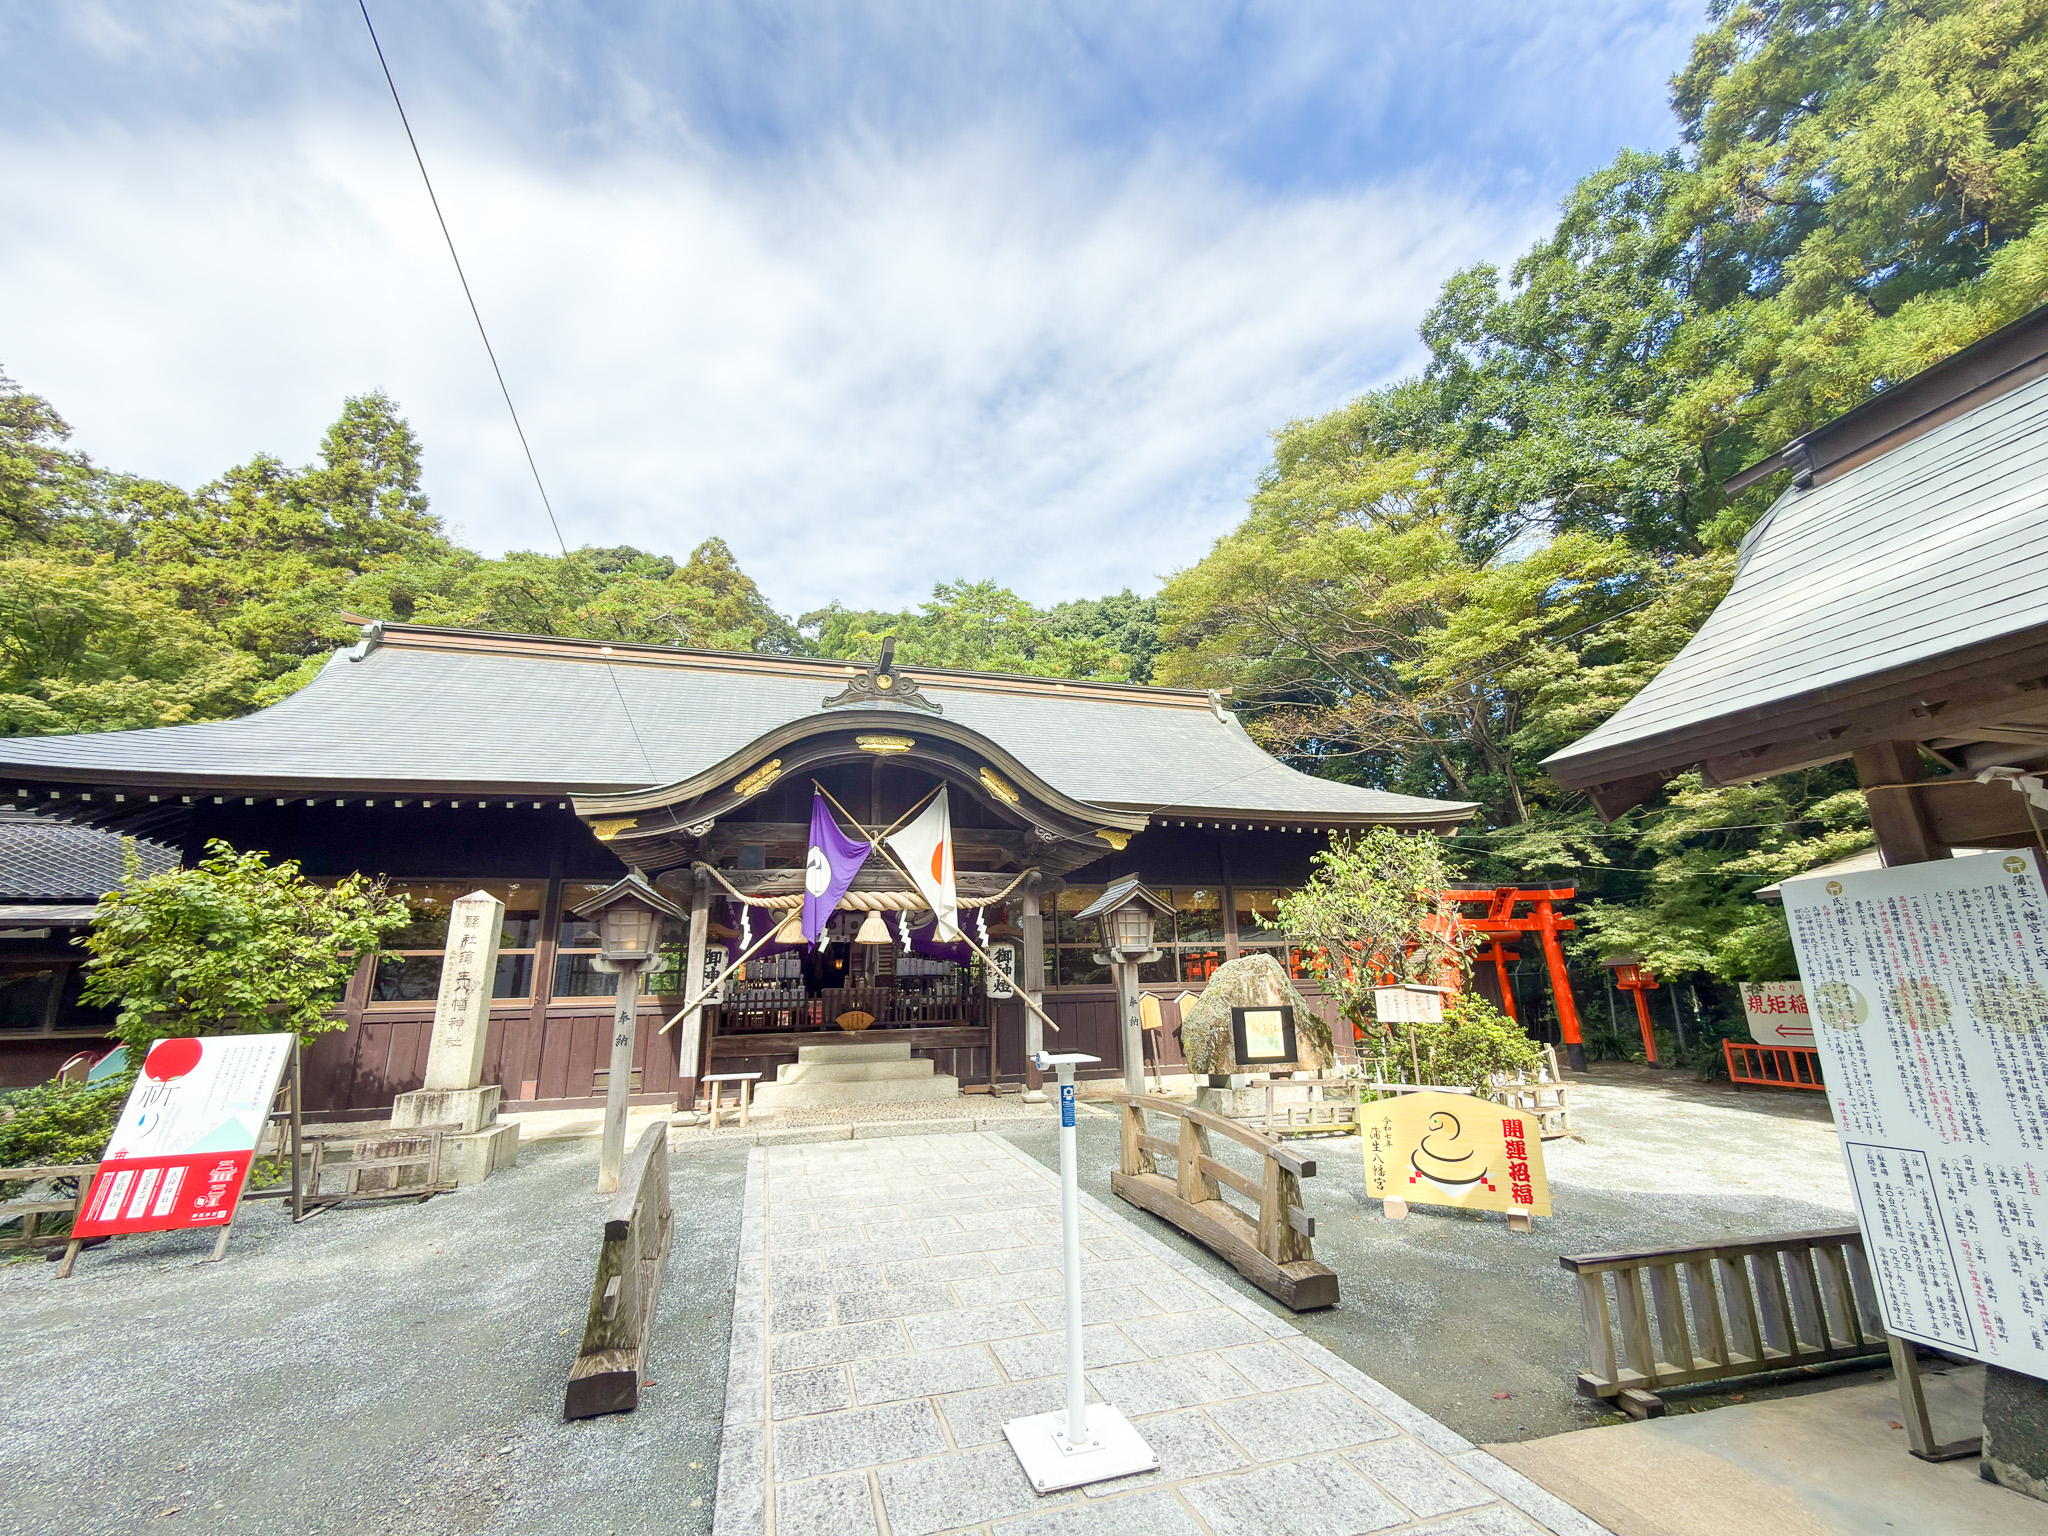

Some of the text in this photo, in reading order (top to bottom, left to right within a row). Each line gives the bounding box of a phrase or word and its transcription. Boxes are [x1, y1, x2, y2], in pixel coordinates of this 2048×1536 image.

[1832, 896, 1860, 976] 氏神様と氏子とは
[1128, 996, 1139, 1027] 奉納
[615, 1010, 631, 1047] 奉納
[1382, 1116, 1394, 1149] 令和七年
[1369, 1127, 1387, 1190] 蒲生八幡宮
[1501, 1118, 1534, 1205] 開運招福
[1866, 1153, 1877, 1177] お問合せ
[1876, 1154, 1888, 1176] 駐車場
[1952, 1165, 1967, 1196] 八百屋町
[2023, 1161, 2040, 1195] 小倉北区
